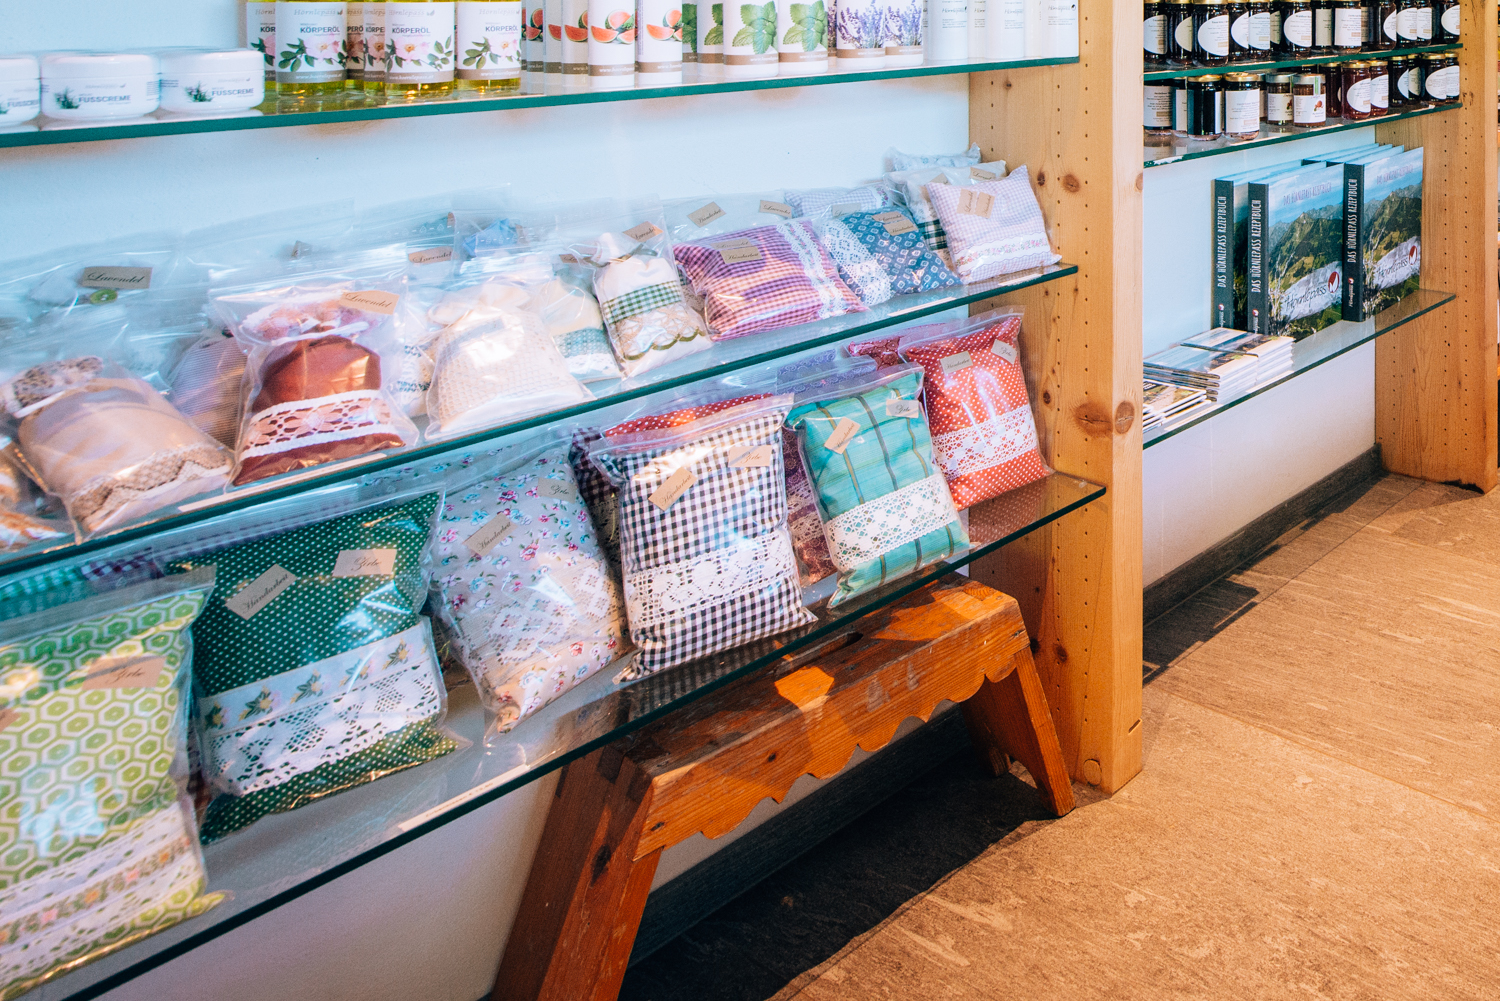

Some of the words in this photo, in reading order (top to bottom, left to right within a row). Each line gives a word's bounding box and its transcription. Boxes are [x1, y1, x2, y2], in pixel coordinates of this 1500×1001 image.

[300, 24, 341, 34] KÖRPERÖL
[392, 26, 431, 35] KÖRPERÖL
[485, 23, 519, 33] KÖRPERÖL
[79, 93, 131, 105] FUSSCREME
[212, 87, 255, 98] FUSSCREME
[1347, 178, 1358, 210] REZEPTBUCH
[1217, 196, 1228, 230] REZEPTBUCH
[1251, 199, 1262, 233] REZEPTBUCH
[1346, 209, 1358, 248] HÖRNLEPASS
[410, 251, 452, 265] Lavendel
[1216, 230, 1228, 272] HÖRNLEPASS
[1250, 233, 1262, 276] HÖRNLEPASS
[1347, 250, 1358, 263] DAS
[86, 270, 146, 285] Lavendel
[1217, 276, 1228, 288] DAS
[1251, 279, 1262, 293] DAS
[345, 292, 393, 310] Lavendel
[895, 403, 912, 416] Zirbe
[743, 452, 763, 465] Zirbe
[549, 483, 570, 497] Zirbe
[660, 474, 693, 507] Handarbeit
[477, 520, 512, 551] Handarbeit
[350, 555, 383, 572] Zirbe
[241, 572, 289, 614] Handarbeit
[104, 667, 147, 686] Zirbe
